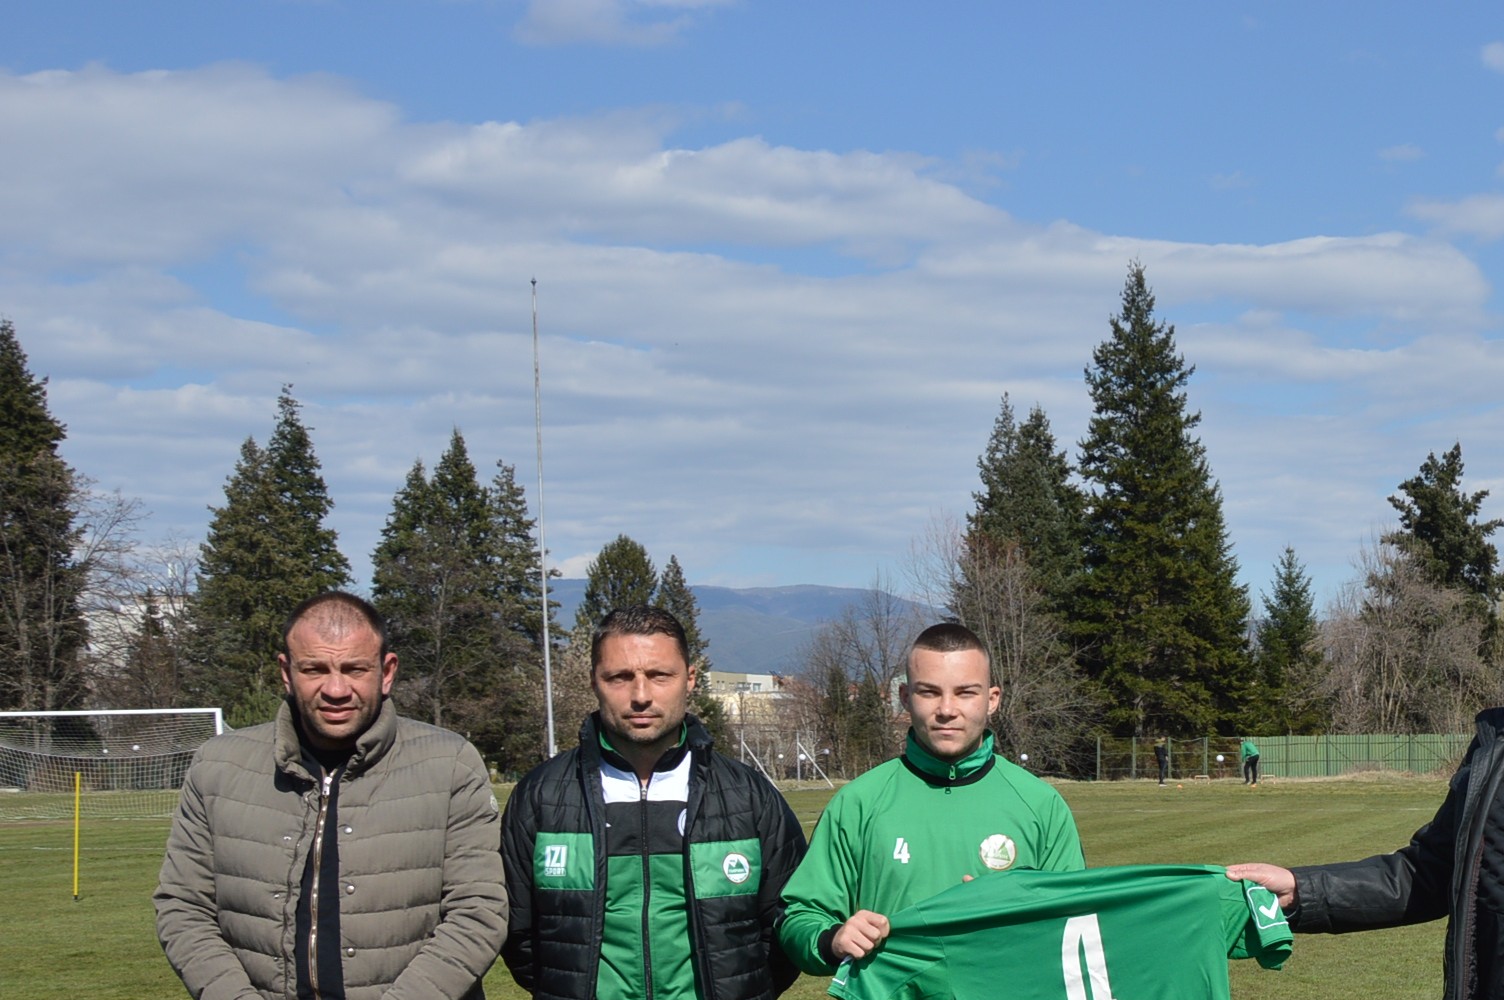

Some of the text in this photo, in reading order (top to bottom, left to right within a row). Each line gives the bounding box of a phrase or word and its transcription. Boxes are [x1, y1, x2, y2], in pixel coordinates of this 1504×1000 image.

[545, 844, 567, 867] IZI
[893, 837, 910, 863] 4
[545, 867, 565, 876] SPORT
